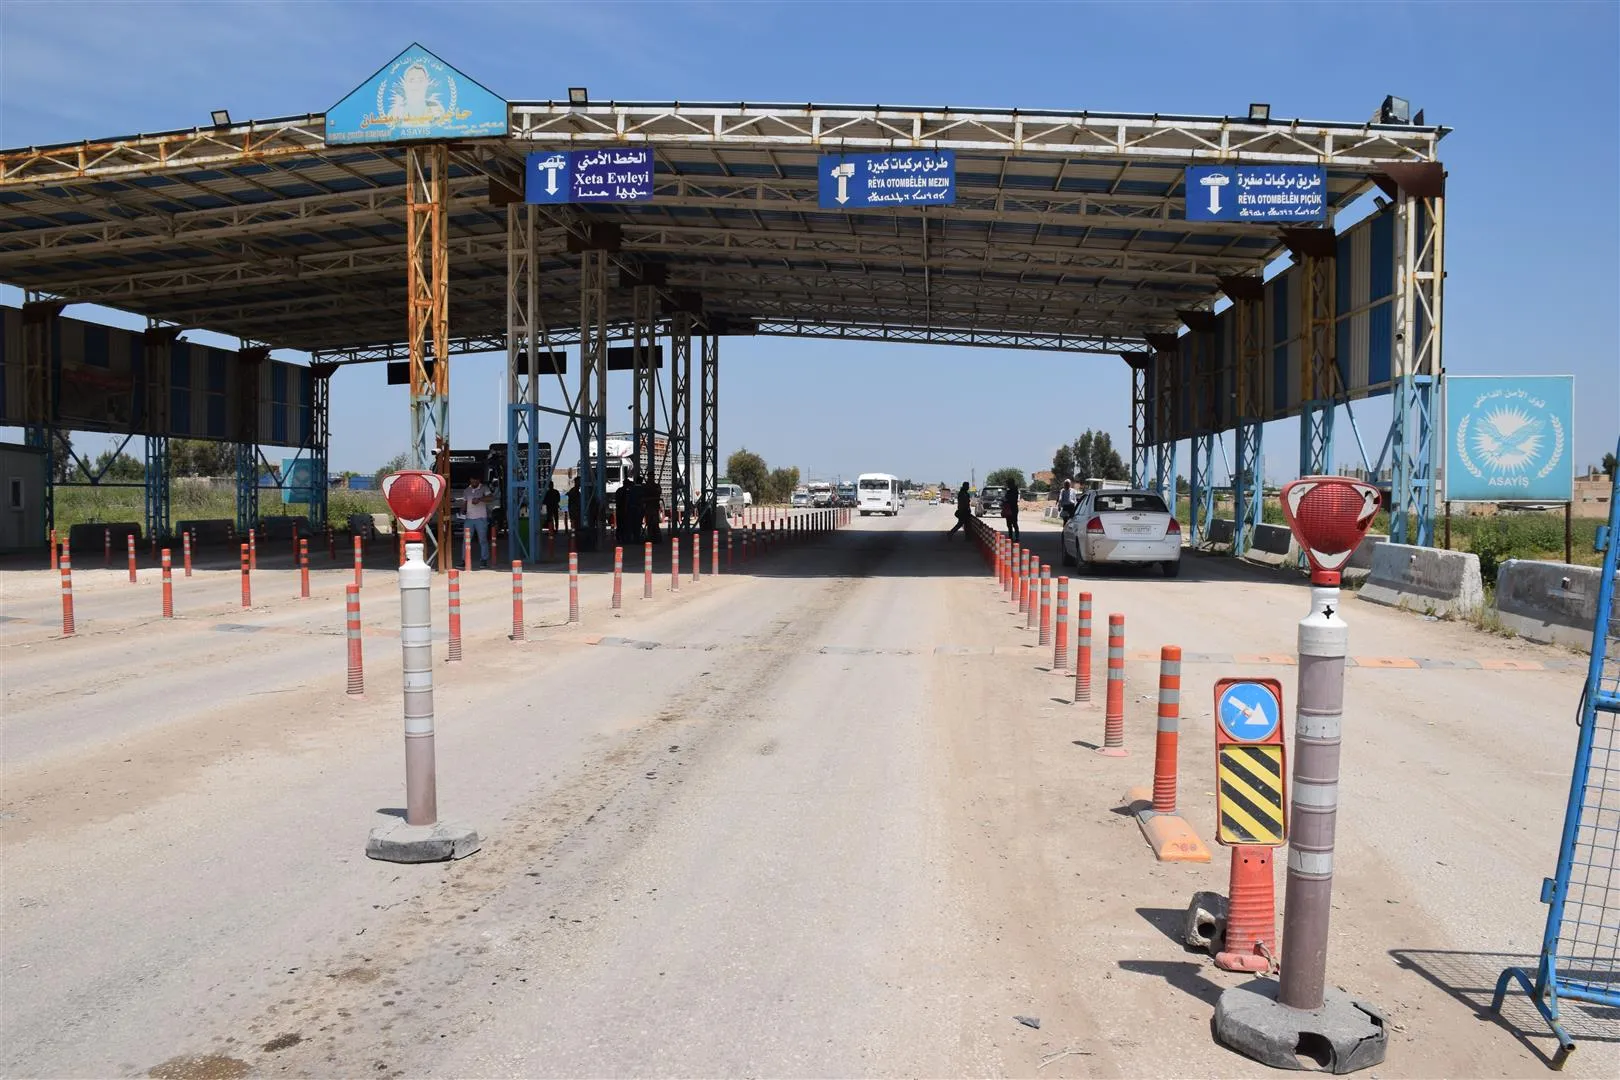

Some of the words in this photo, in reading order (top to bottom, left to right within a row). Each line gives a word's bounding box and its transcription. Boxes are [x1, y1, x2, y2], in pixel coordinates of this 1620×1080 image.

[577, 151, 611, 170] الأمني
[613, 152, 647, 165] الخط
[867, 159, 889, 173] كبيرة
[890, 157, 922, 173] مركبات
[922, 156, 949, 172] طريق
[575, 172, 604, 186] Xeta
[607, 171, 650, 186] Ewleyi
[867, 175, 886, 189] RÊYA
[886, 174, 927, 188] OTOMBÊLÊN
[928, 177, 950, 188] MEZIN
[1238, 173, 1263, 189] صغيرة
[1264, 173, 1295, 190] مركبات
[1296, 173, 1321, 189] طريق
[1238, 192, 1257, 204] RÊYA
[1257, 191, 1300, 205] OTOMBÊLÊN
[1300, 192, 1322, 206] PIÇÛK
